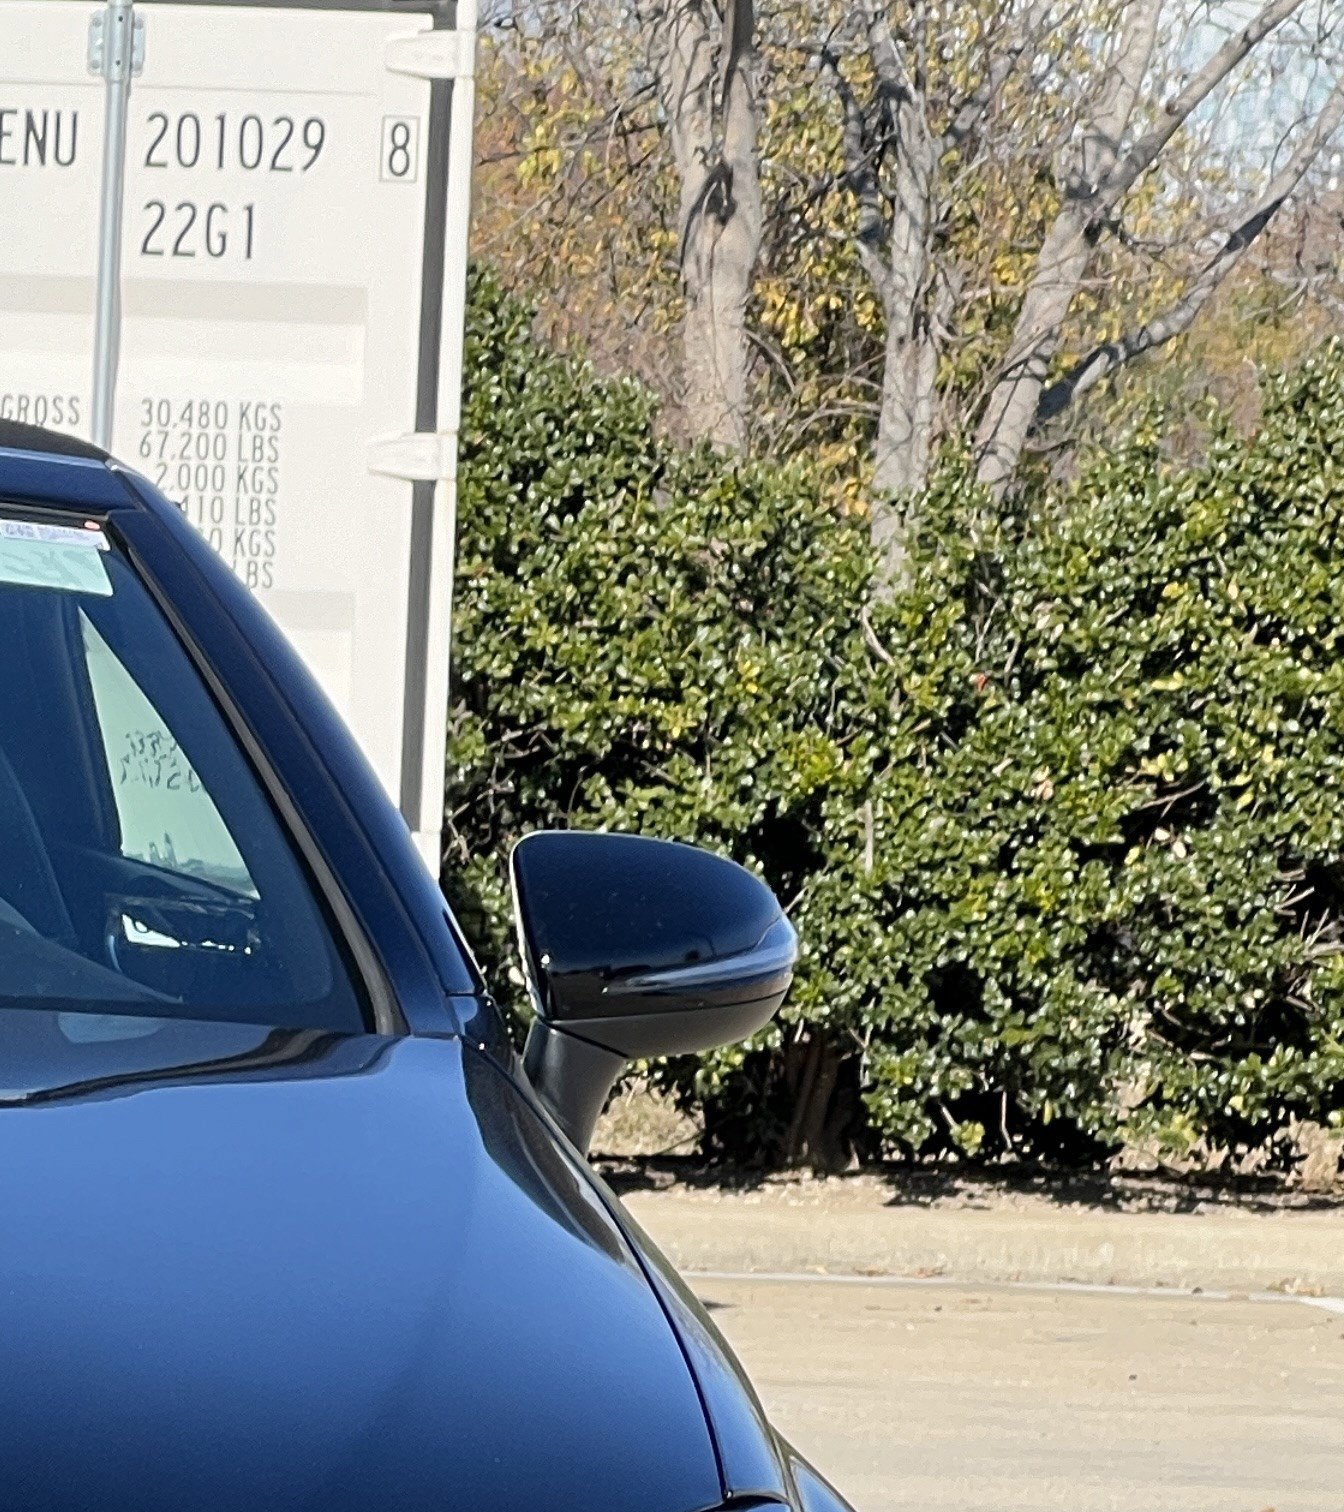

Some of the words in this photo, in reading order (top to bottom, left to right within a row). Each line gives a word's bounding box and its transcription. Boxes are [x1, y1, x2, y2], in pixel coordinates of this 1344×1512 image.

[143, 111, 326, 173] 201029
[387, 120, 411, 178] 8
[140, 200, 255, 260] 22G1
[0, 393, 80, 426] GROSS
[238, 400, 282, 432] KGS
[237, 433, 280, 463] LBS
[236, 465, 280, 495] KGS
[234, 496, 276, 526] LBS
[232, 528, 275, 558] KGS
